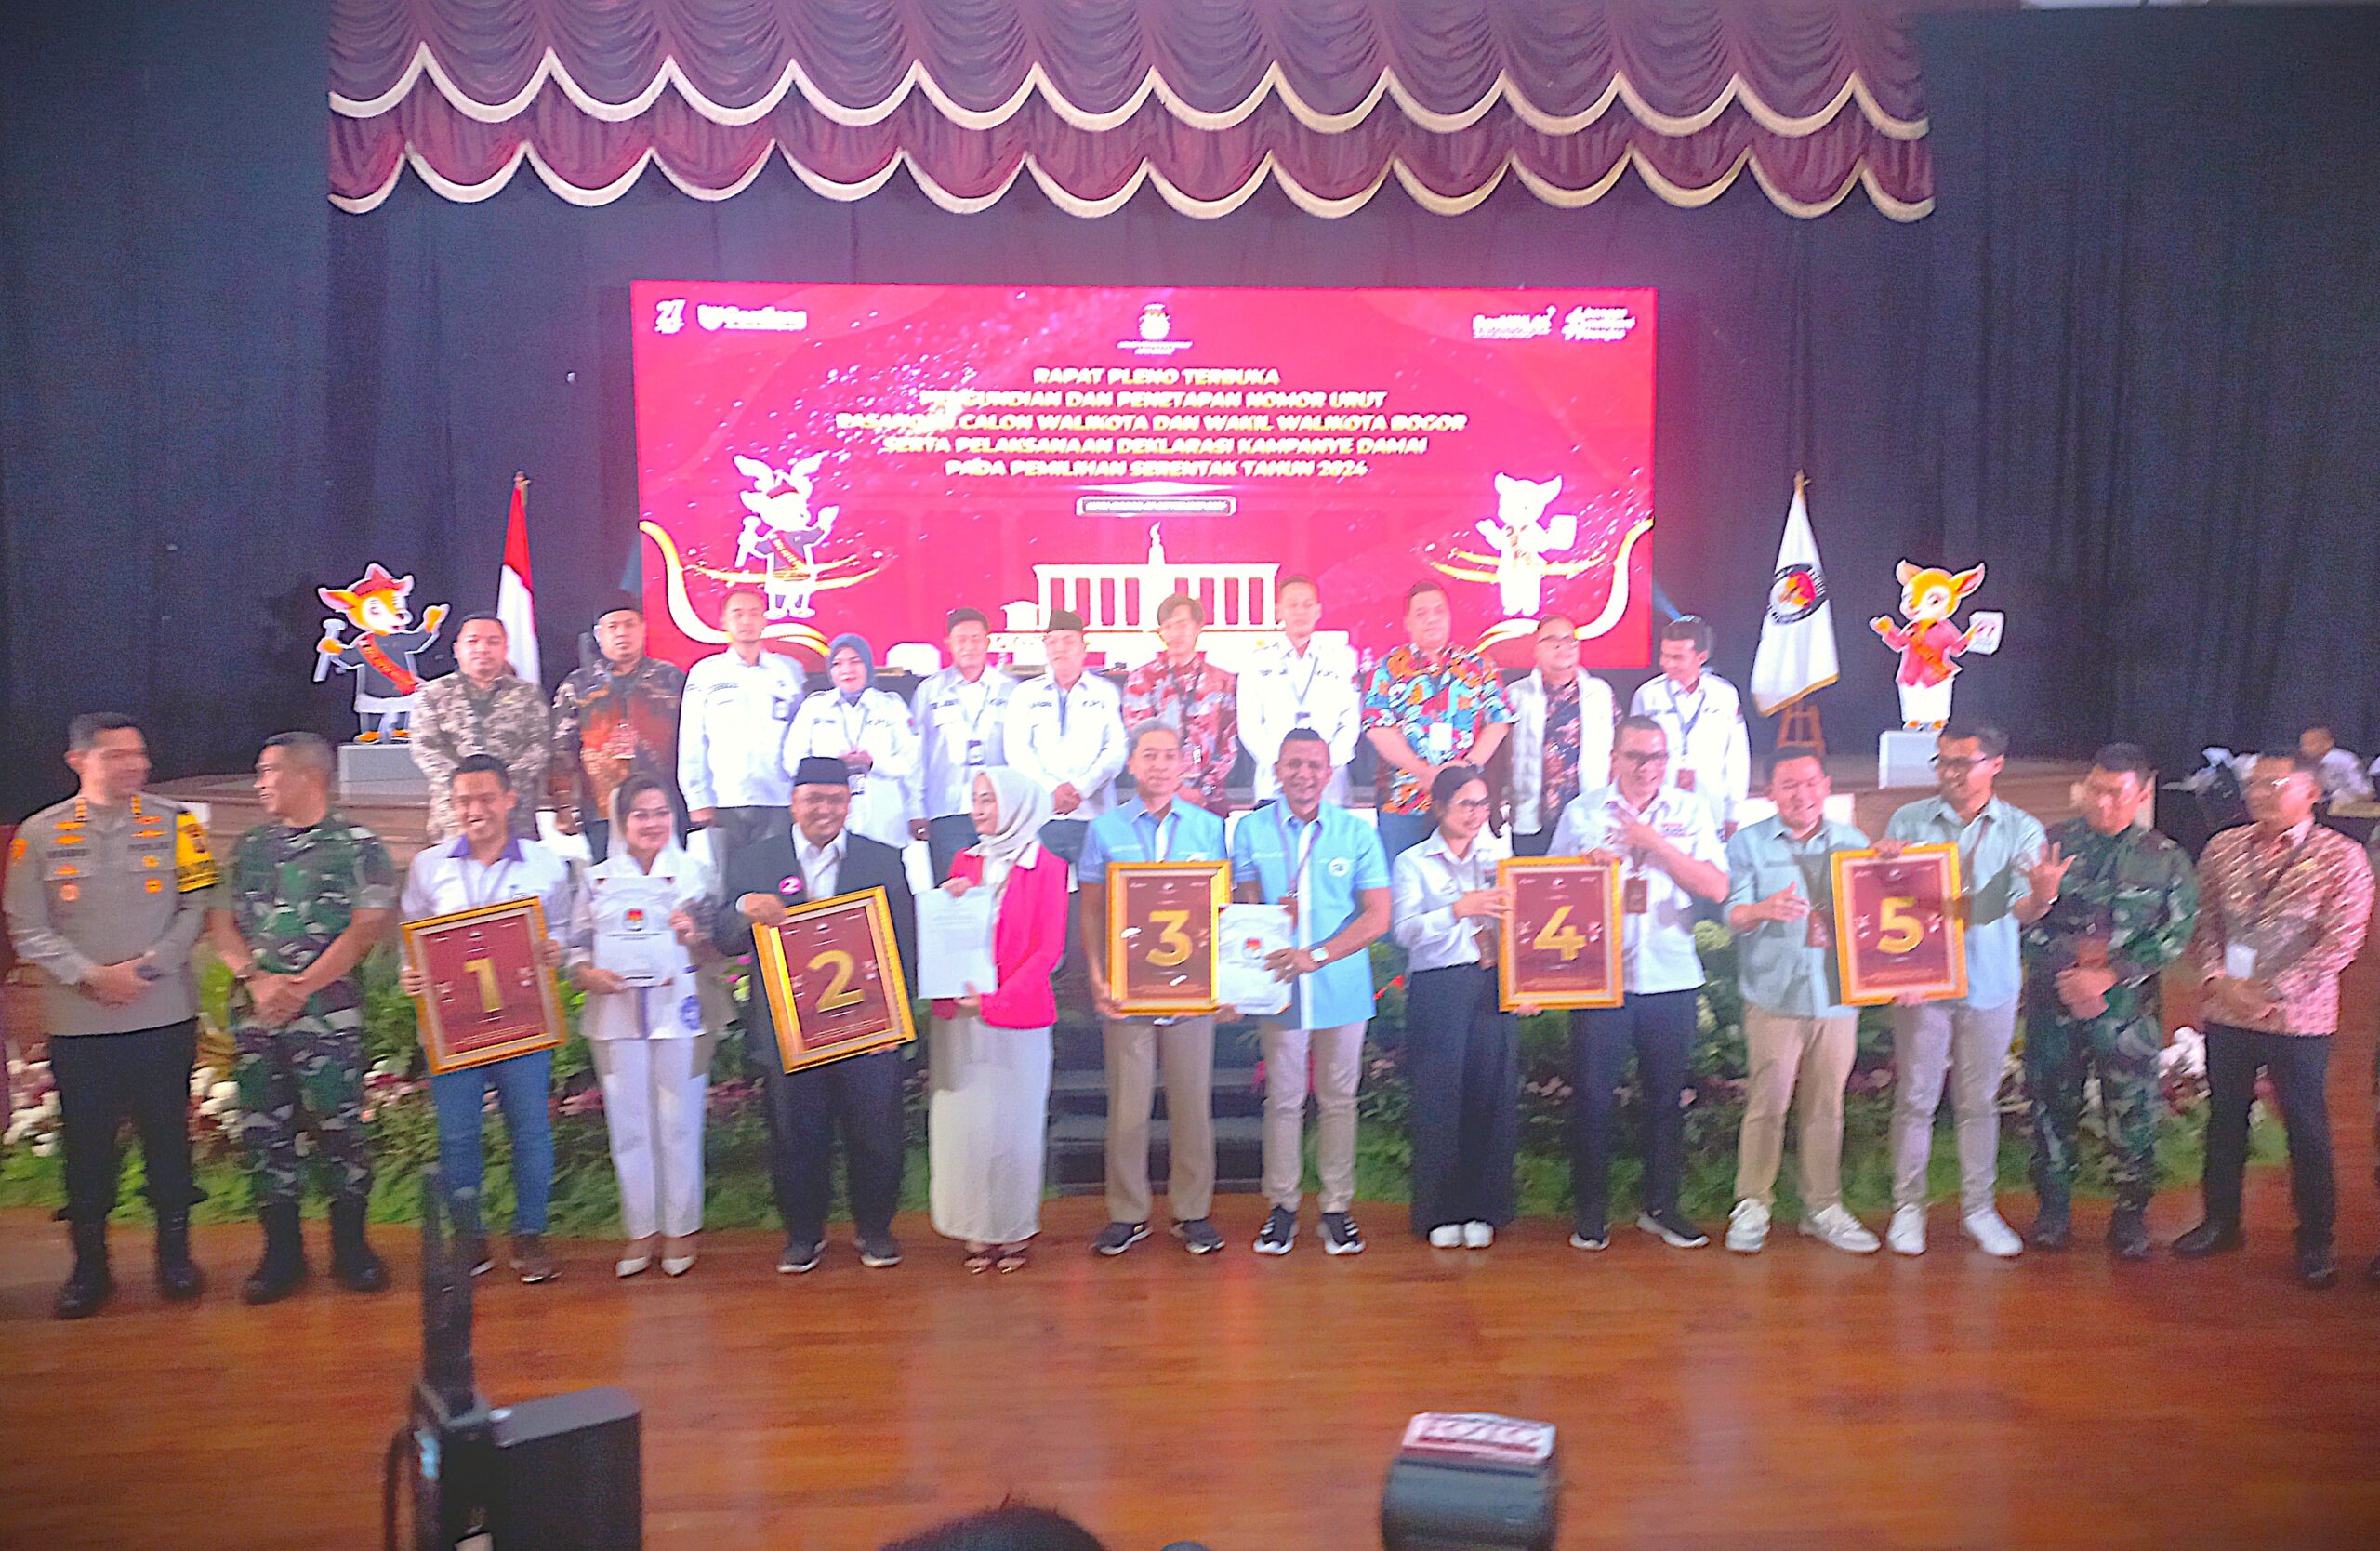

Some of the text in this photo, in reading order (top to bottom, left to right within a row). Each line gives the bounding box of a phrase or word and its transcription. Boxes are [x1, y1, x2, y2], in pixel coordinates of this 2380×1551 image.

[1033, 367, 1281, 385] RAPAT PLENO TERBUKA
[1065, 391, 1113, 407] DAN
[1116, 391, 1242, 408] PENETAPAN
[1245, 391, 1327, 408] NOMOR
[1329, 391, 1388, 408] URUT
[959, 414, 1033, 431] CALON
[1036, 414, 1148, 431] WALIKOTA
[1153, 415, 1201, 431] DAN
[1203, 415, 1274, 431] WAKIL
[1276, 415, 1388, 431] WALIKOTA
[1391, 415, 1468, 431] BOGOR
[955, 437, 1113, 454] PELAKSANAAN
[1116, 437, 1234, 455] DEKLARASI
[1237, 437, 1355, 455] KAMPANYE
[1356, 438, 1429, 455] DAMAI
[945, 459, 1369, 477] PADA PEMILIHAN SERENTAK TAHUN 2024
[784, 876, 798, 890] 2
[1534, 905, 1587, 961] 4
[1876, 896, 1924, 954] 5
[1145, 909, 1194, 967] 3
[465, 957, 502, 1014] 1
[806, 948, 865, 1014] 2
